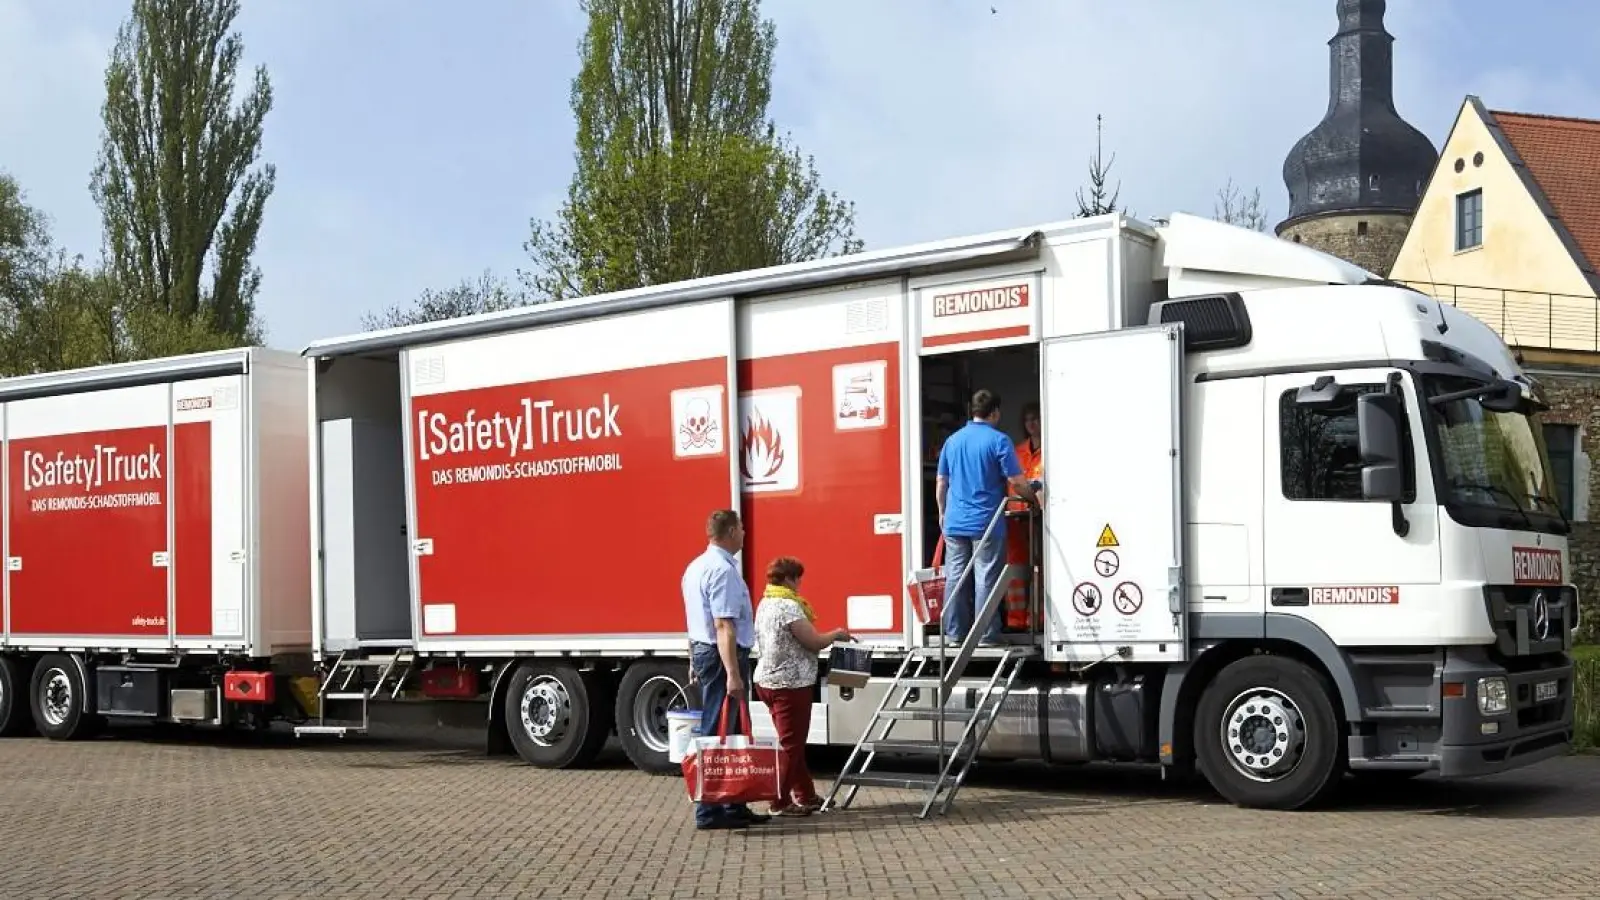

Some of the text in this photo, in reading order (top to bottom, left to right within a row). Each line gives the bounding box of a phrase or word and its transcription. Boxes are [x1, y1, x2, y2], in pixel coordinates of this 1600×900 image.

[935, 287, 1022, 316] REMONDIS
[432, 453, 623, 486] DAS REMONDIS-SCHADSTOFFMOBIL
[31, 497, 47, 512] DAS
[1514, 551, 1559, 580] REMONDIS
[1313, 588, 1392, 603] REMONDIS
[714, 754, 730, 764] den
